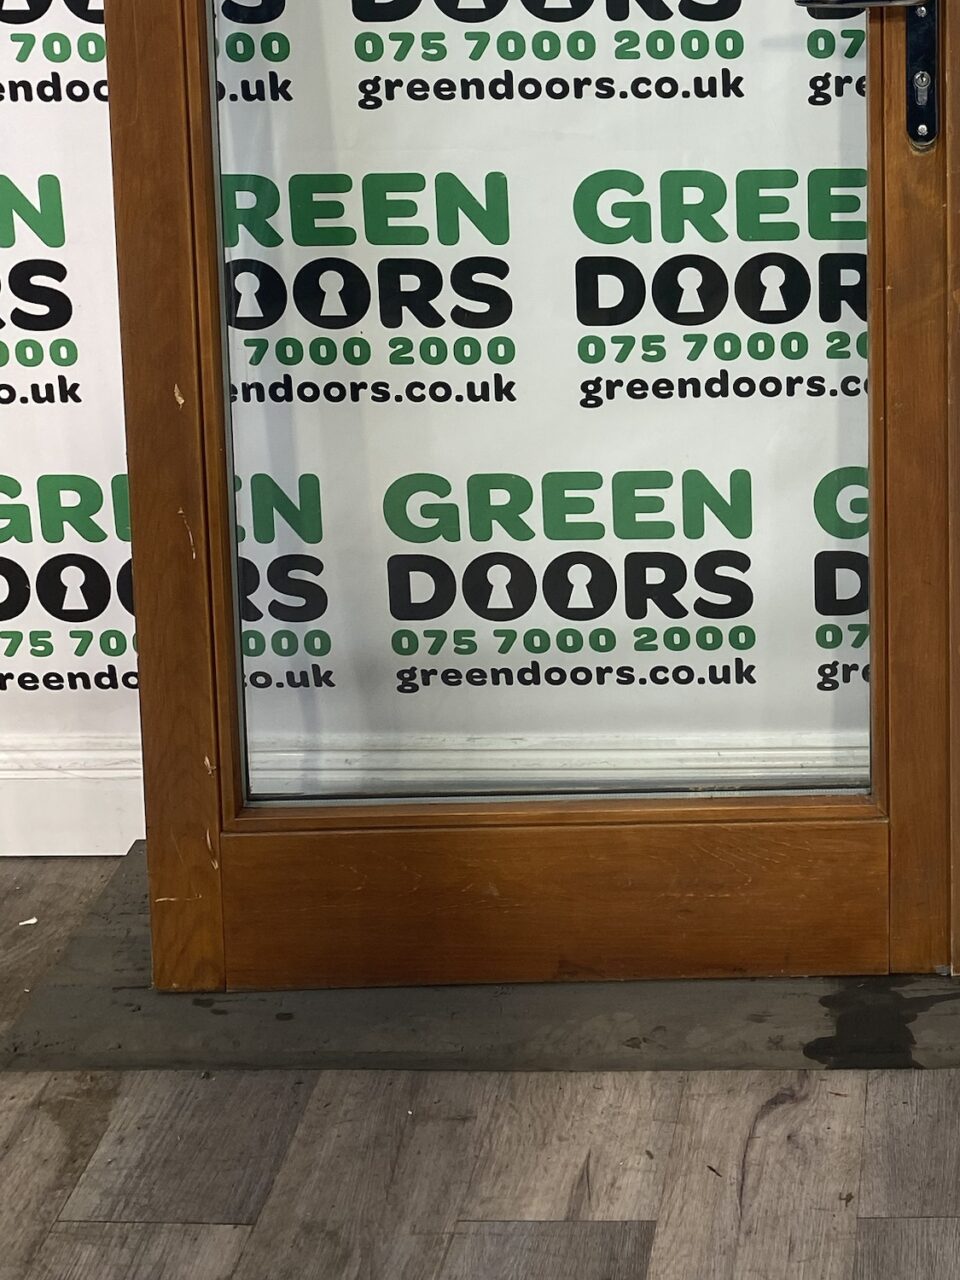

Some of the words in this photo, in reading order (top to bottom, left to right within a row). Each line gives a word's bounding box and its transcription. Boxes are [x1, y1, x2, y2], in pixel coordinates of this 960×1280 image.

[353, 31, 447, 64] 075
[464, 30, 596, 61] 7000
[614, 29, 744, 60] 2000
[357, 68, 745, 111] greendoors.co.uk
[242, 336, 373, 367] 7000
[388, 336, 516, 366] 2000
[577, 334, 666, 364] 075
[683, 331, 809, 361] 7000
[231, 374, 517, 404] ndoors.co.uk
[579, 370, 868, 408] greendoors.c
[384, 469, 753, 544] GREEN
[388, 550, 753, 622] DOORS
[393, 628, 479, 656] 075
[495, 626, 617, 655] 7000
[633, 624, 757, 653] 2000
[396, 658, 757, 693] greendoors.co.uk
